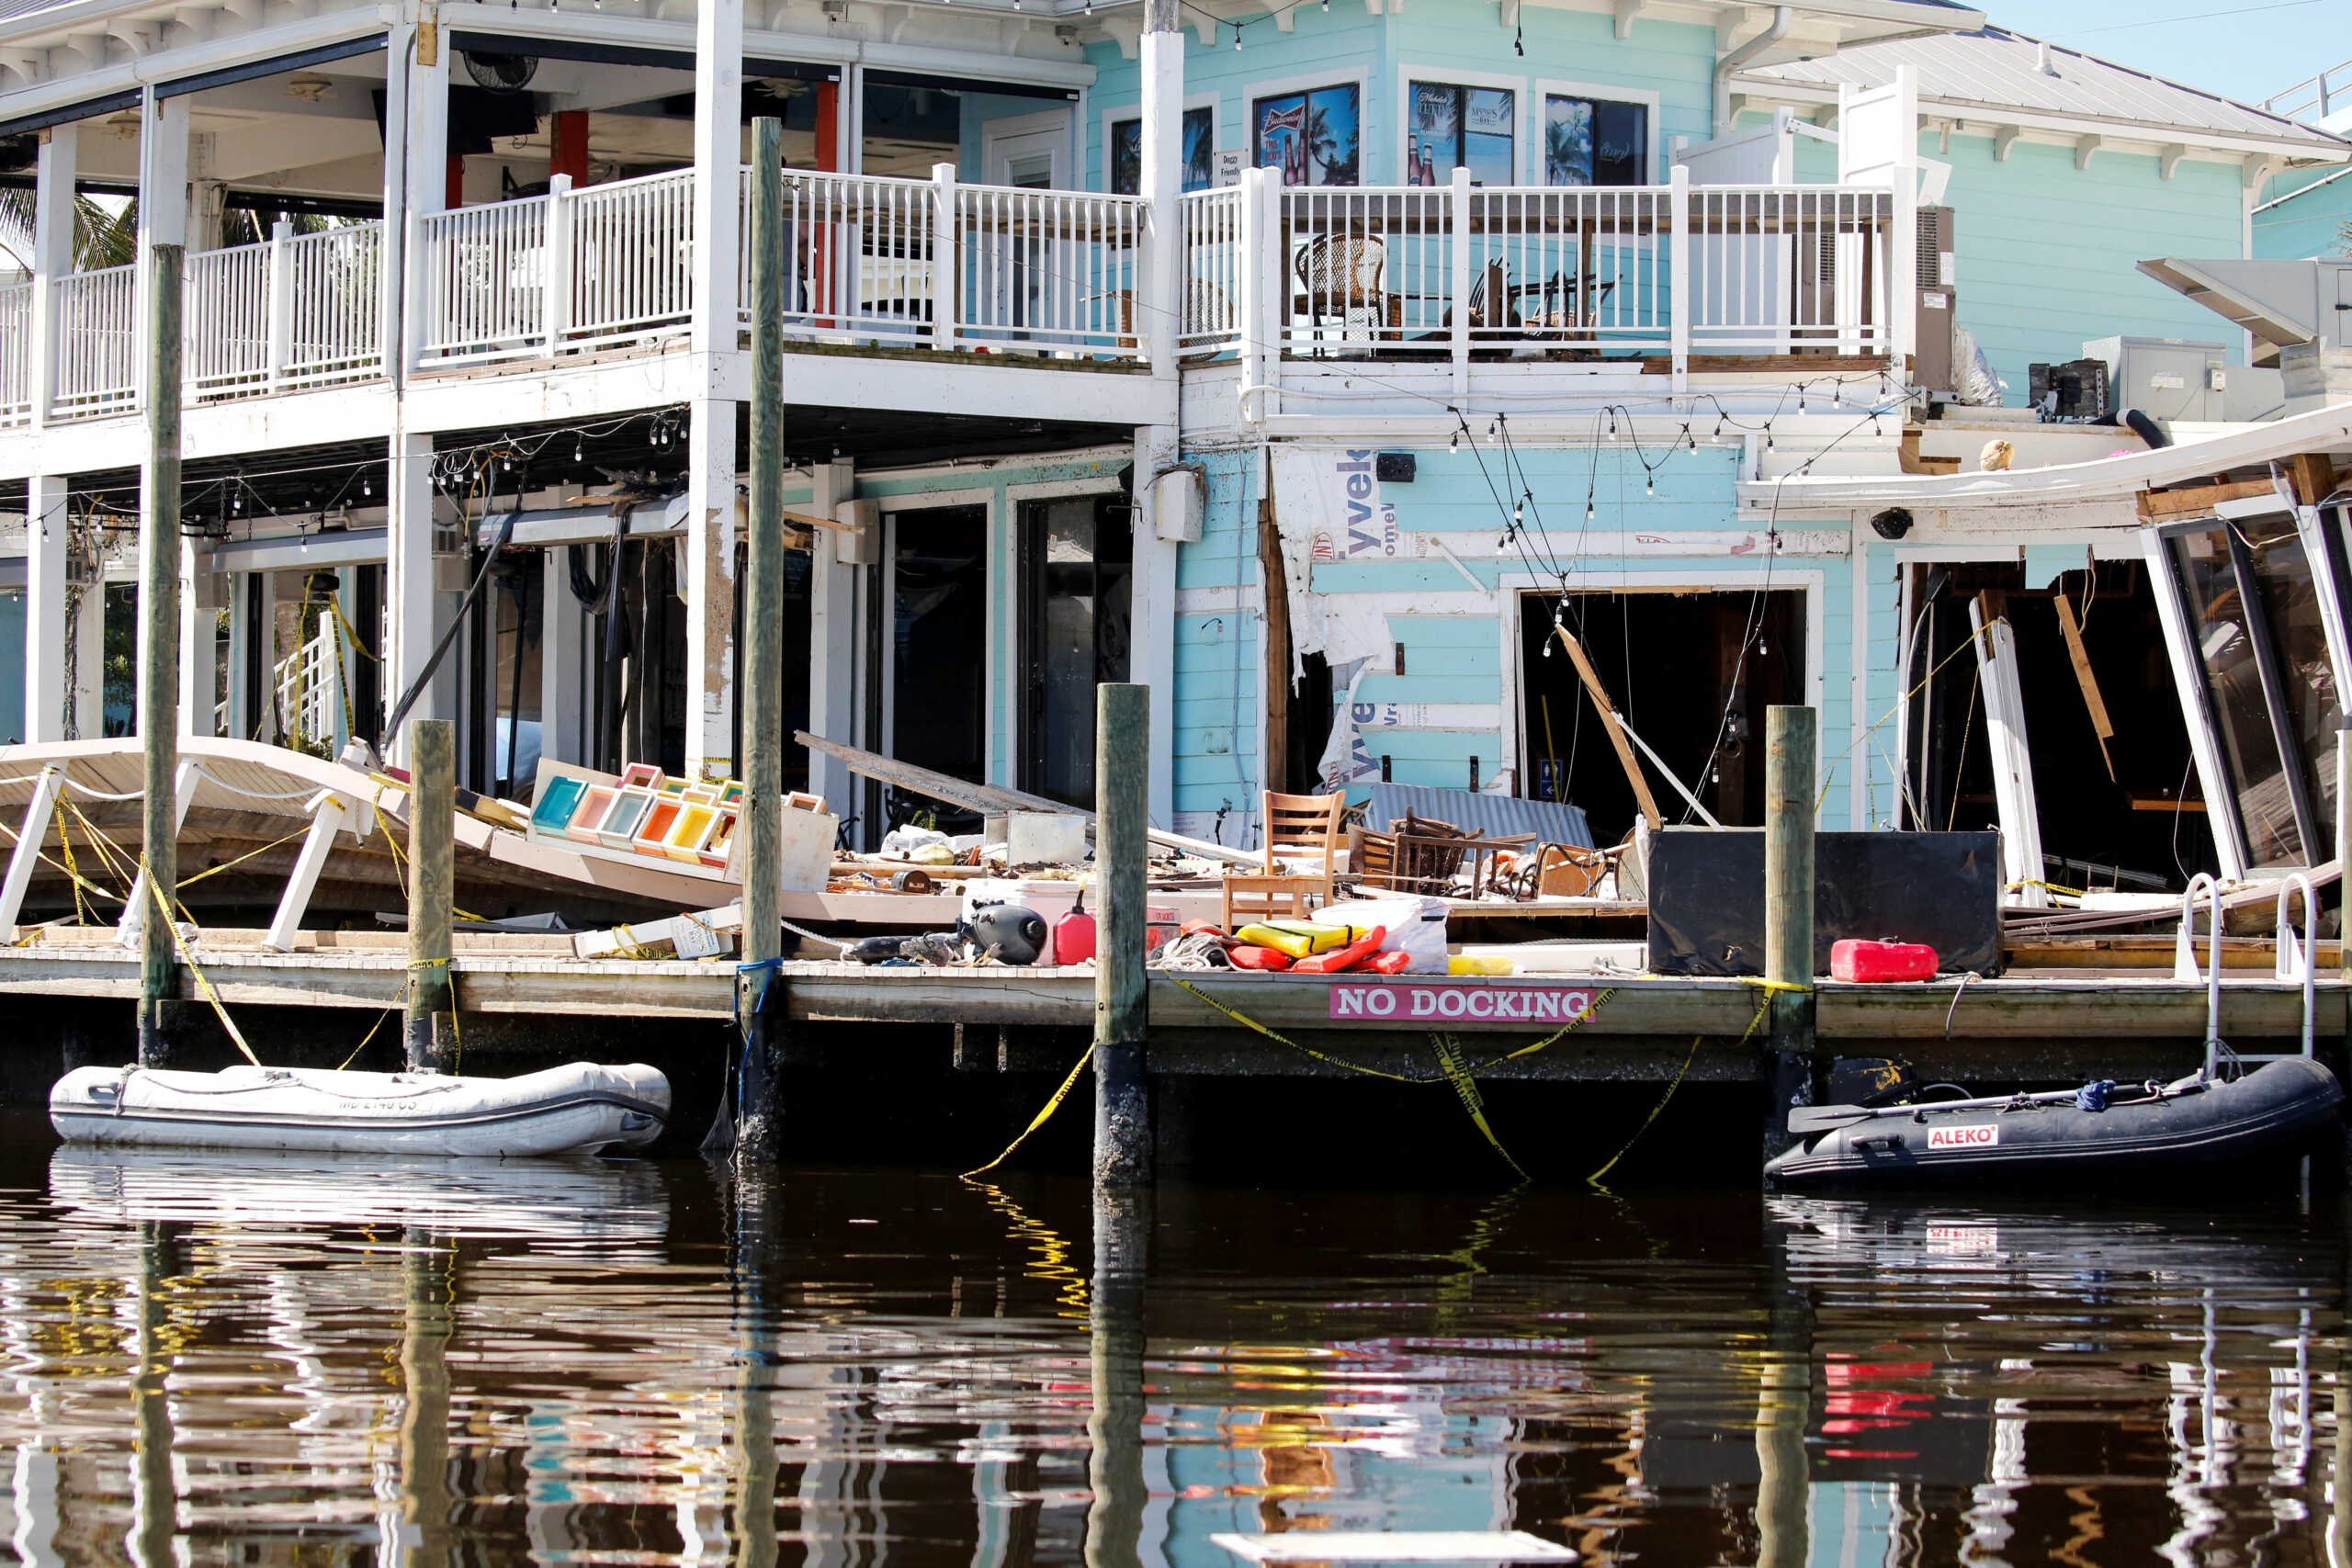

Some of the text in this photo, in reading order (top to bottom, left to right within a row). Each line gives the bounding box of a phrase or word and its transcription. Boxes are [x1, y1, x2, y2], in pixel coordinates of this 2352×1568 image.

[1223, 155, 1238, 164] Doggy
[1220, 166, 1241, 177] Friendly
[1338, 988, 1589, 1019] NO DOCKING
